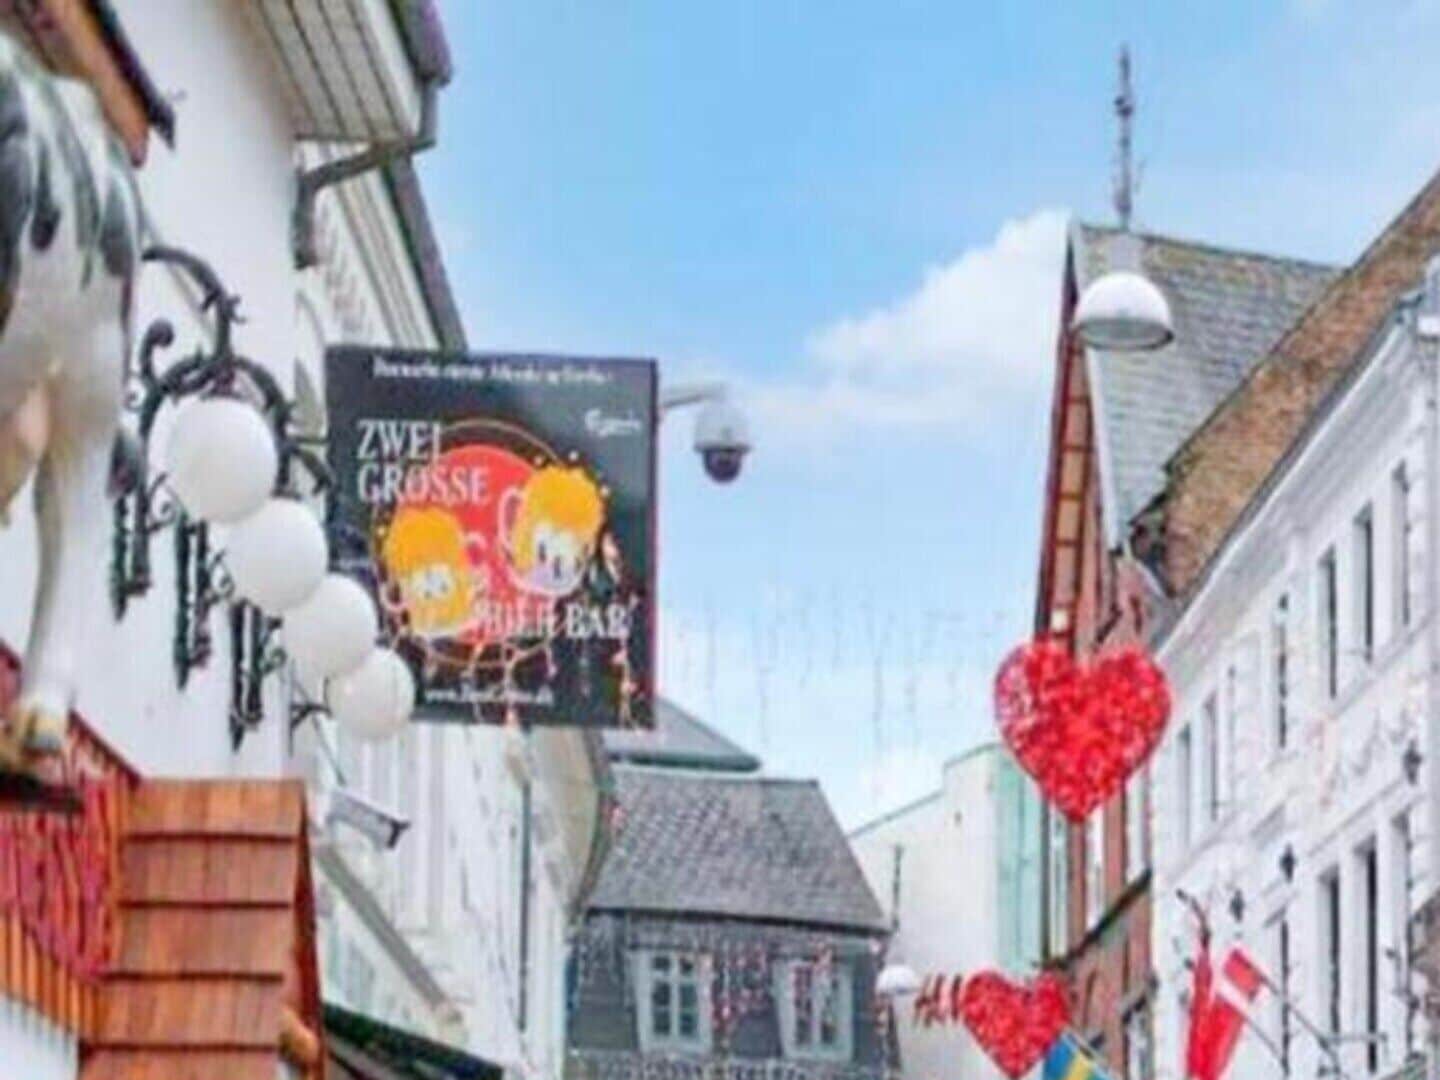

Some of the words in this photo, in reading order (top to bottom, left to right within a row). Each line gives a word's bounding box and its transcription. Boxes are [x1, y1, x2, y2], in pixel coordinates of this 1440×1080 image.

[355, 418, 442, 460] ZWEI
[356, 463, 492, 502] GROSSE
[565, 602, 630, 639] BAR
